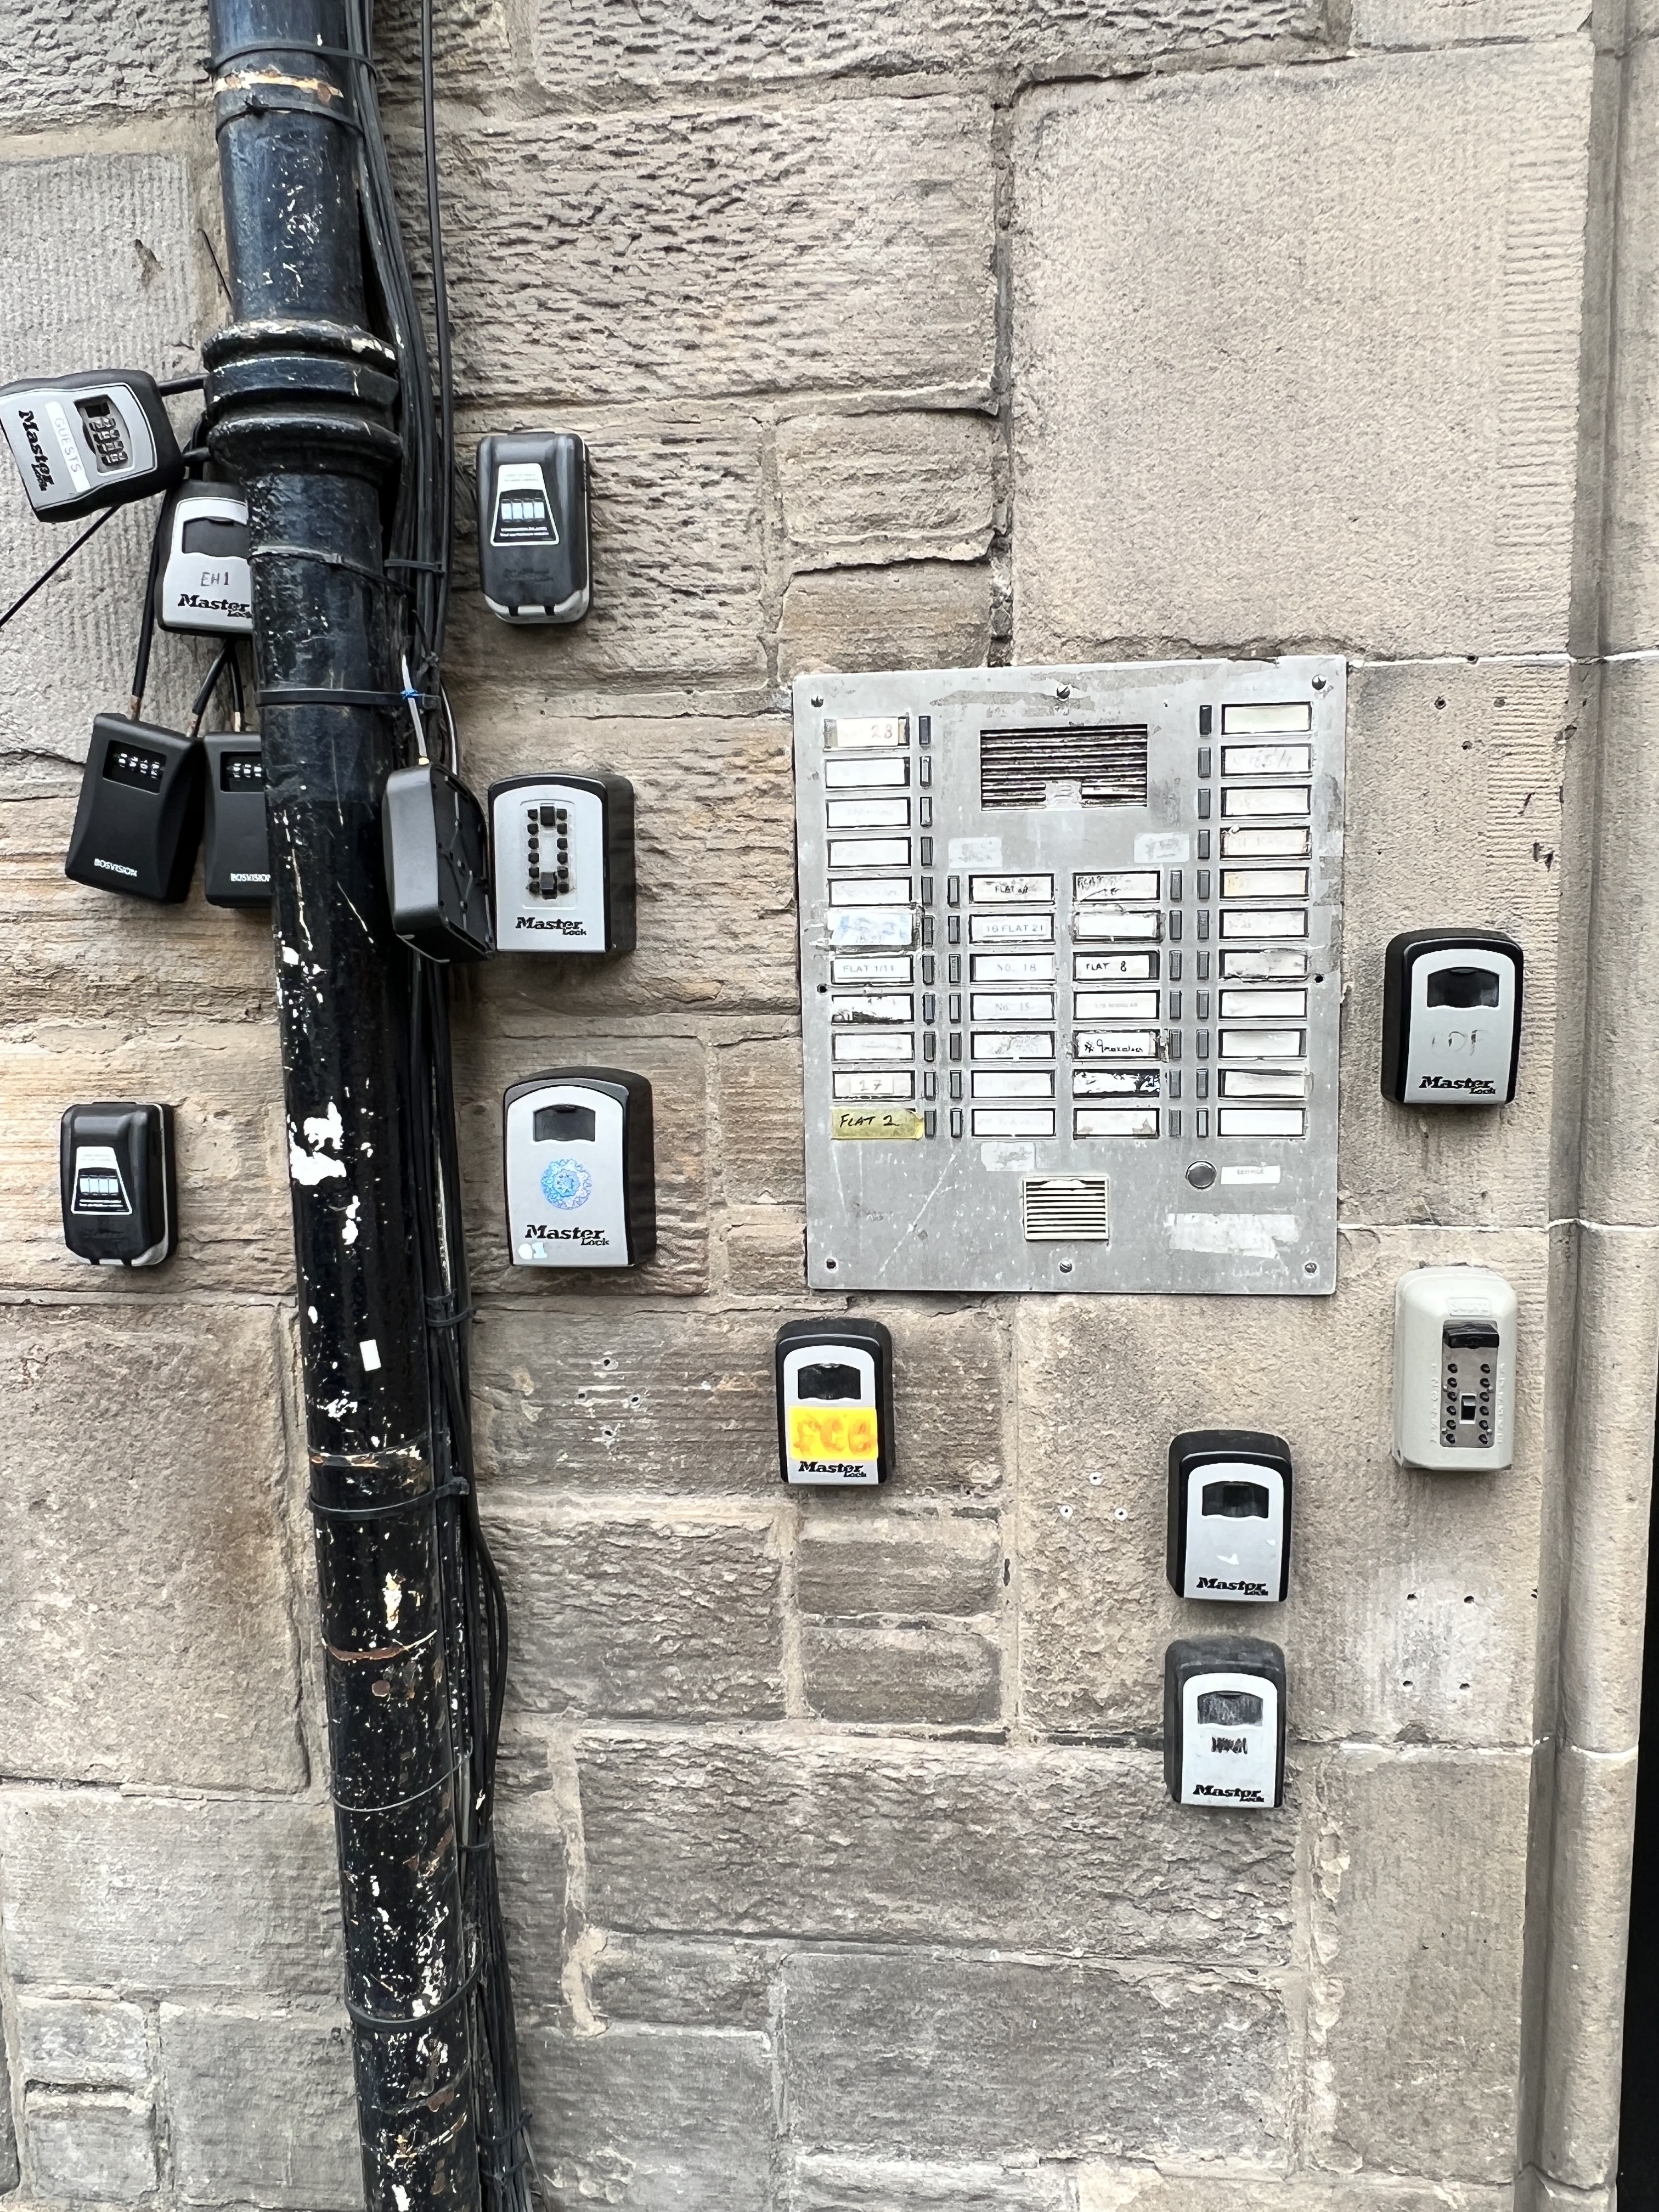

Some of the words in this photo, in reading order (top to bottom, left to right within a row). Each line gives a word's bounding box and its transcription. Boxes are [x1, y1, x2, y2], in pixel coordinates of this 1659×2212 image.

[18, 410, 54, 485] Master
[54, 417, 83, 473] GUESTS
[178, 594, 250, 611] Master
[516, 917, 583, 930] Master
[1024, 963, 1036, 972] 18
[1086, 962, 1110, 971] FLAT
[1120, 961, 1127, 972] 8
[1419, 1076, 1494, 1089] Master
[883, 1114, 900, 1126] 2
[525, 1224, 605, 1240] Master
[580, 1237, 610, 1246] Lock
[798, 1461, 864, 1474] Master
[1197, 1577, 1267, 1590] Master
[1193, 1784, 1262, 1797] Master
